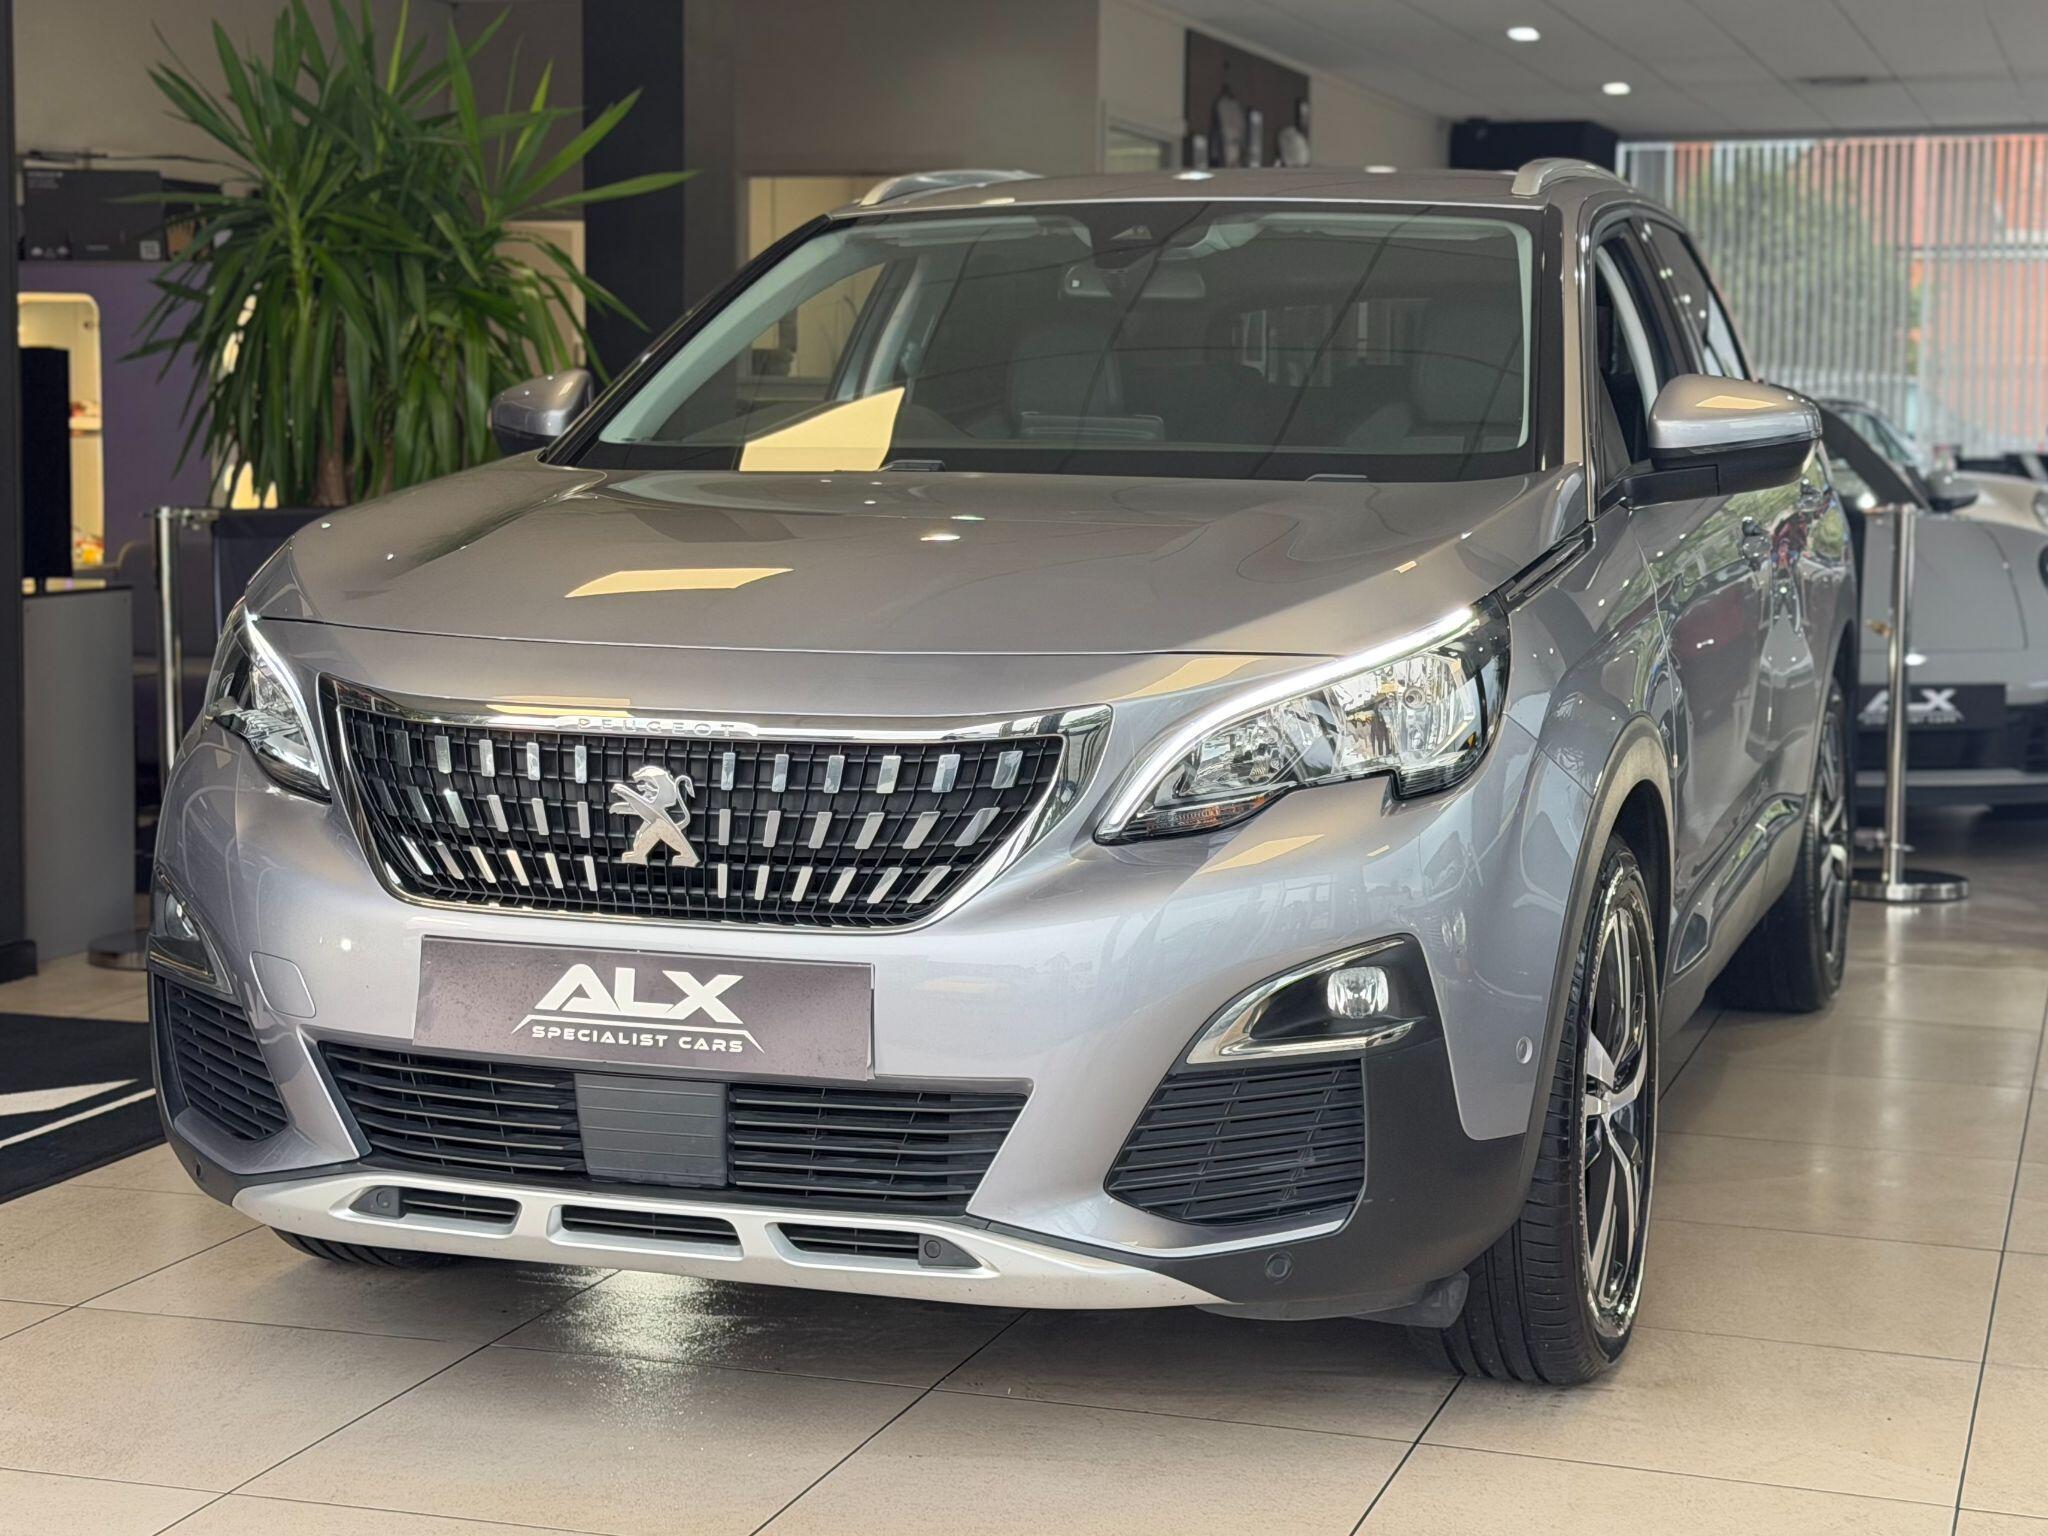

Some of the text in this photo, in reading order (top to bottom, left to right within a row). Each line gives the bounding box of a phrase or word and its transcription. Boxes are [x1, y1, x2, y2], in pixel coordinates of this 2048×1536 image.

[578, 718, 735, 737] PEUGEOT
[534, 963, 744, 1025] ALX
[531, 1025, 743, 1053] SPECIALIST CARS
